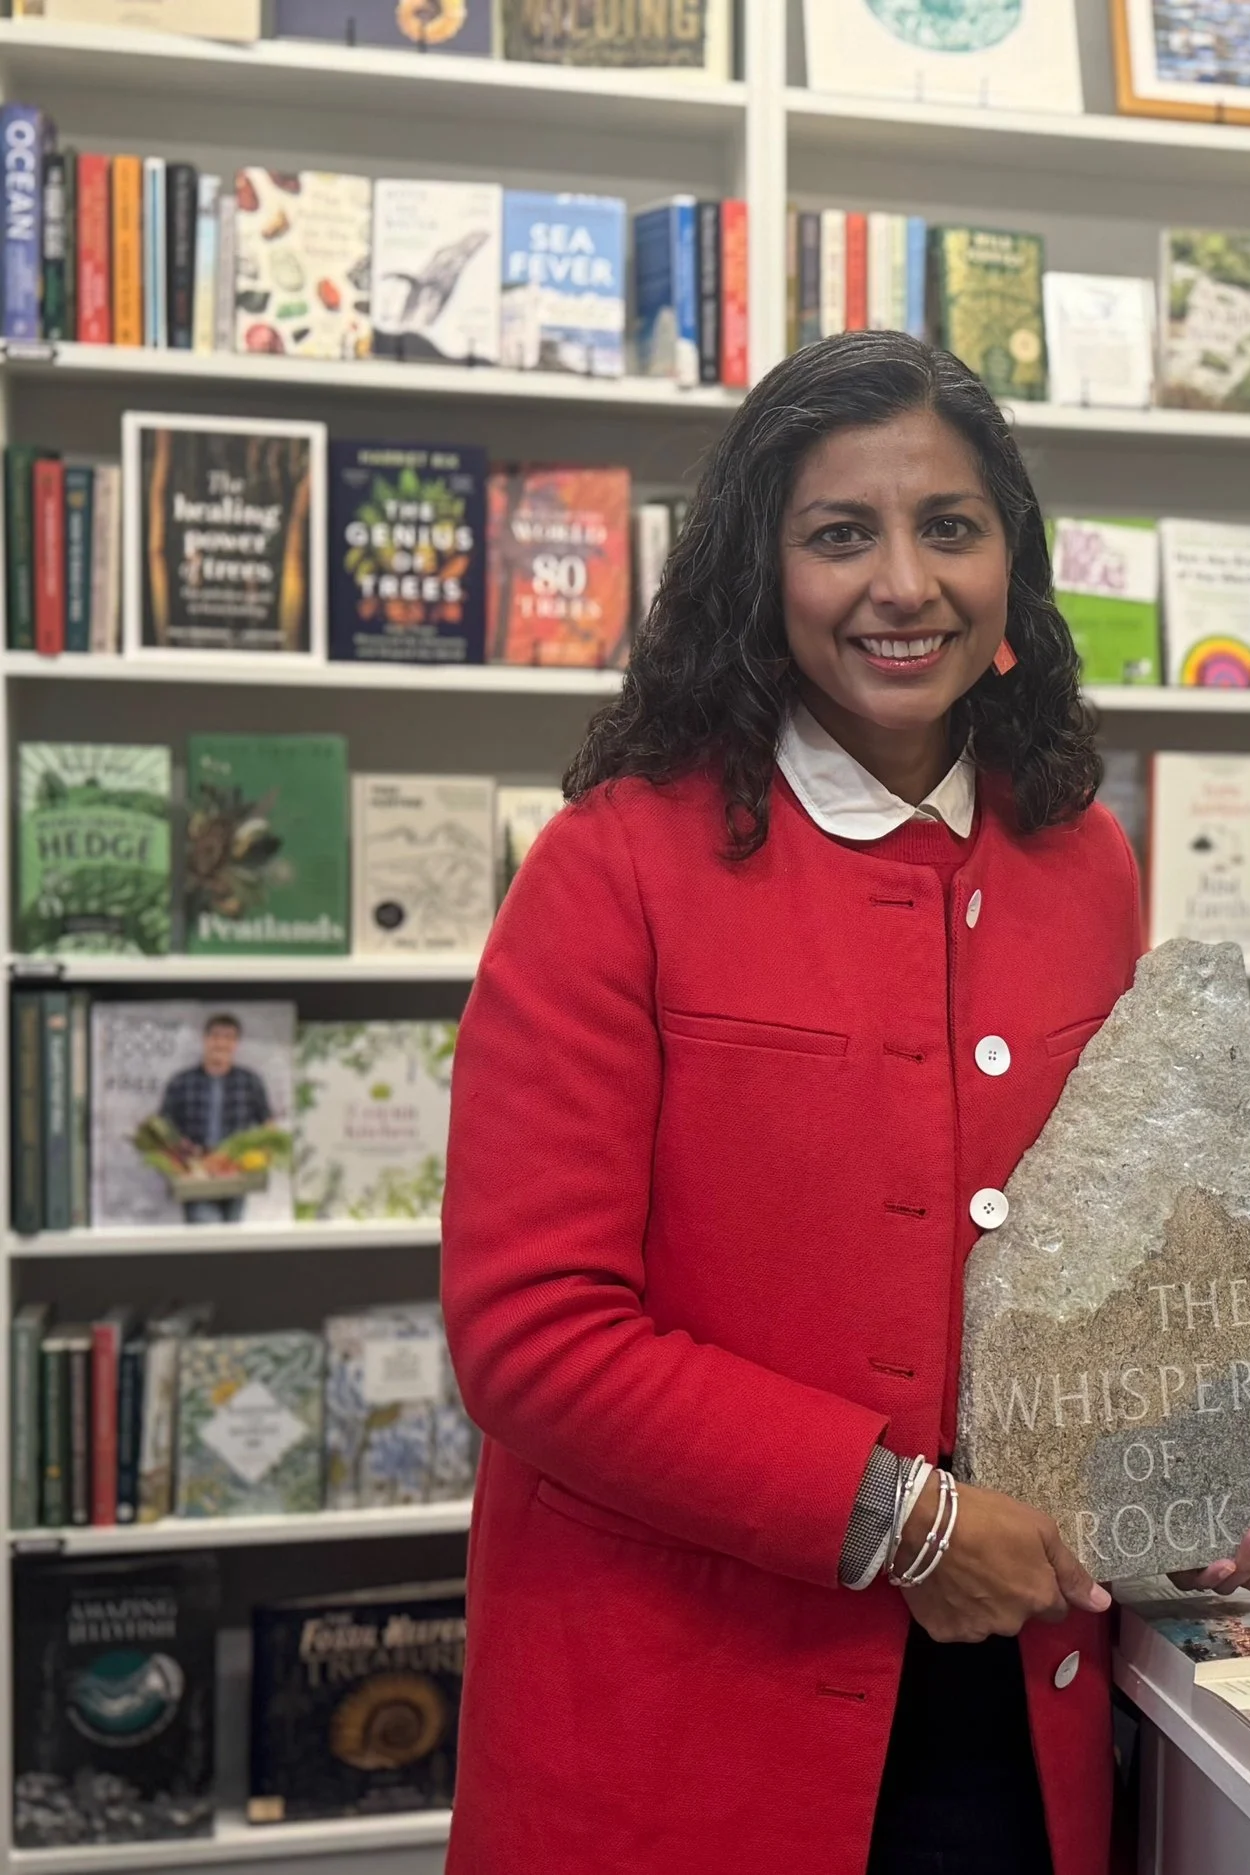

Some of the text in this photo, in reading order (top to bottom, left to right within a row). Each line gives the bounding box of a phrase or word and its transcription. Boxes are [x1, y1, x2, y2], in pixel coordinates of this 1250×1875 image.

[5, 117, 37, 242] OCEAN
[529, 222, 595, 254] SEA
[510, 253, 615, 286] FEVER
[346, 522, 473, 551] GENIUS
[362, 575, 464, 601] TREES
[533, 554, 587, 598] 80
[37, 832, 153, 863] HEDGE
[1122, 1440, 1176, 1482] OF
[1073, 1492, 1241, 1564] ROCK
[305, 1645, 467, 1688] TREASUR
